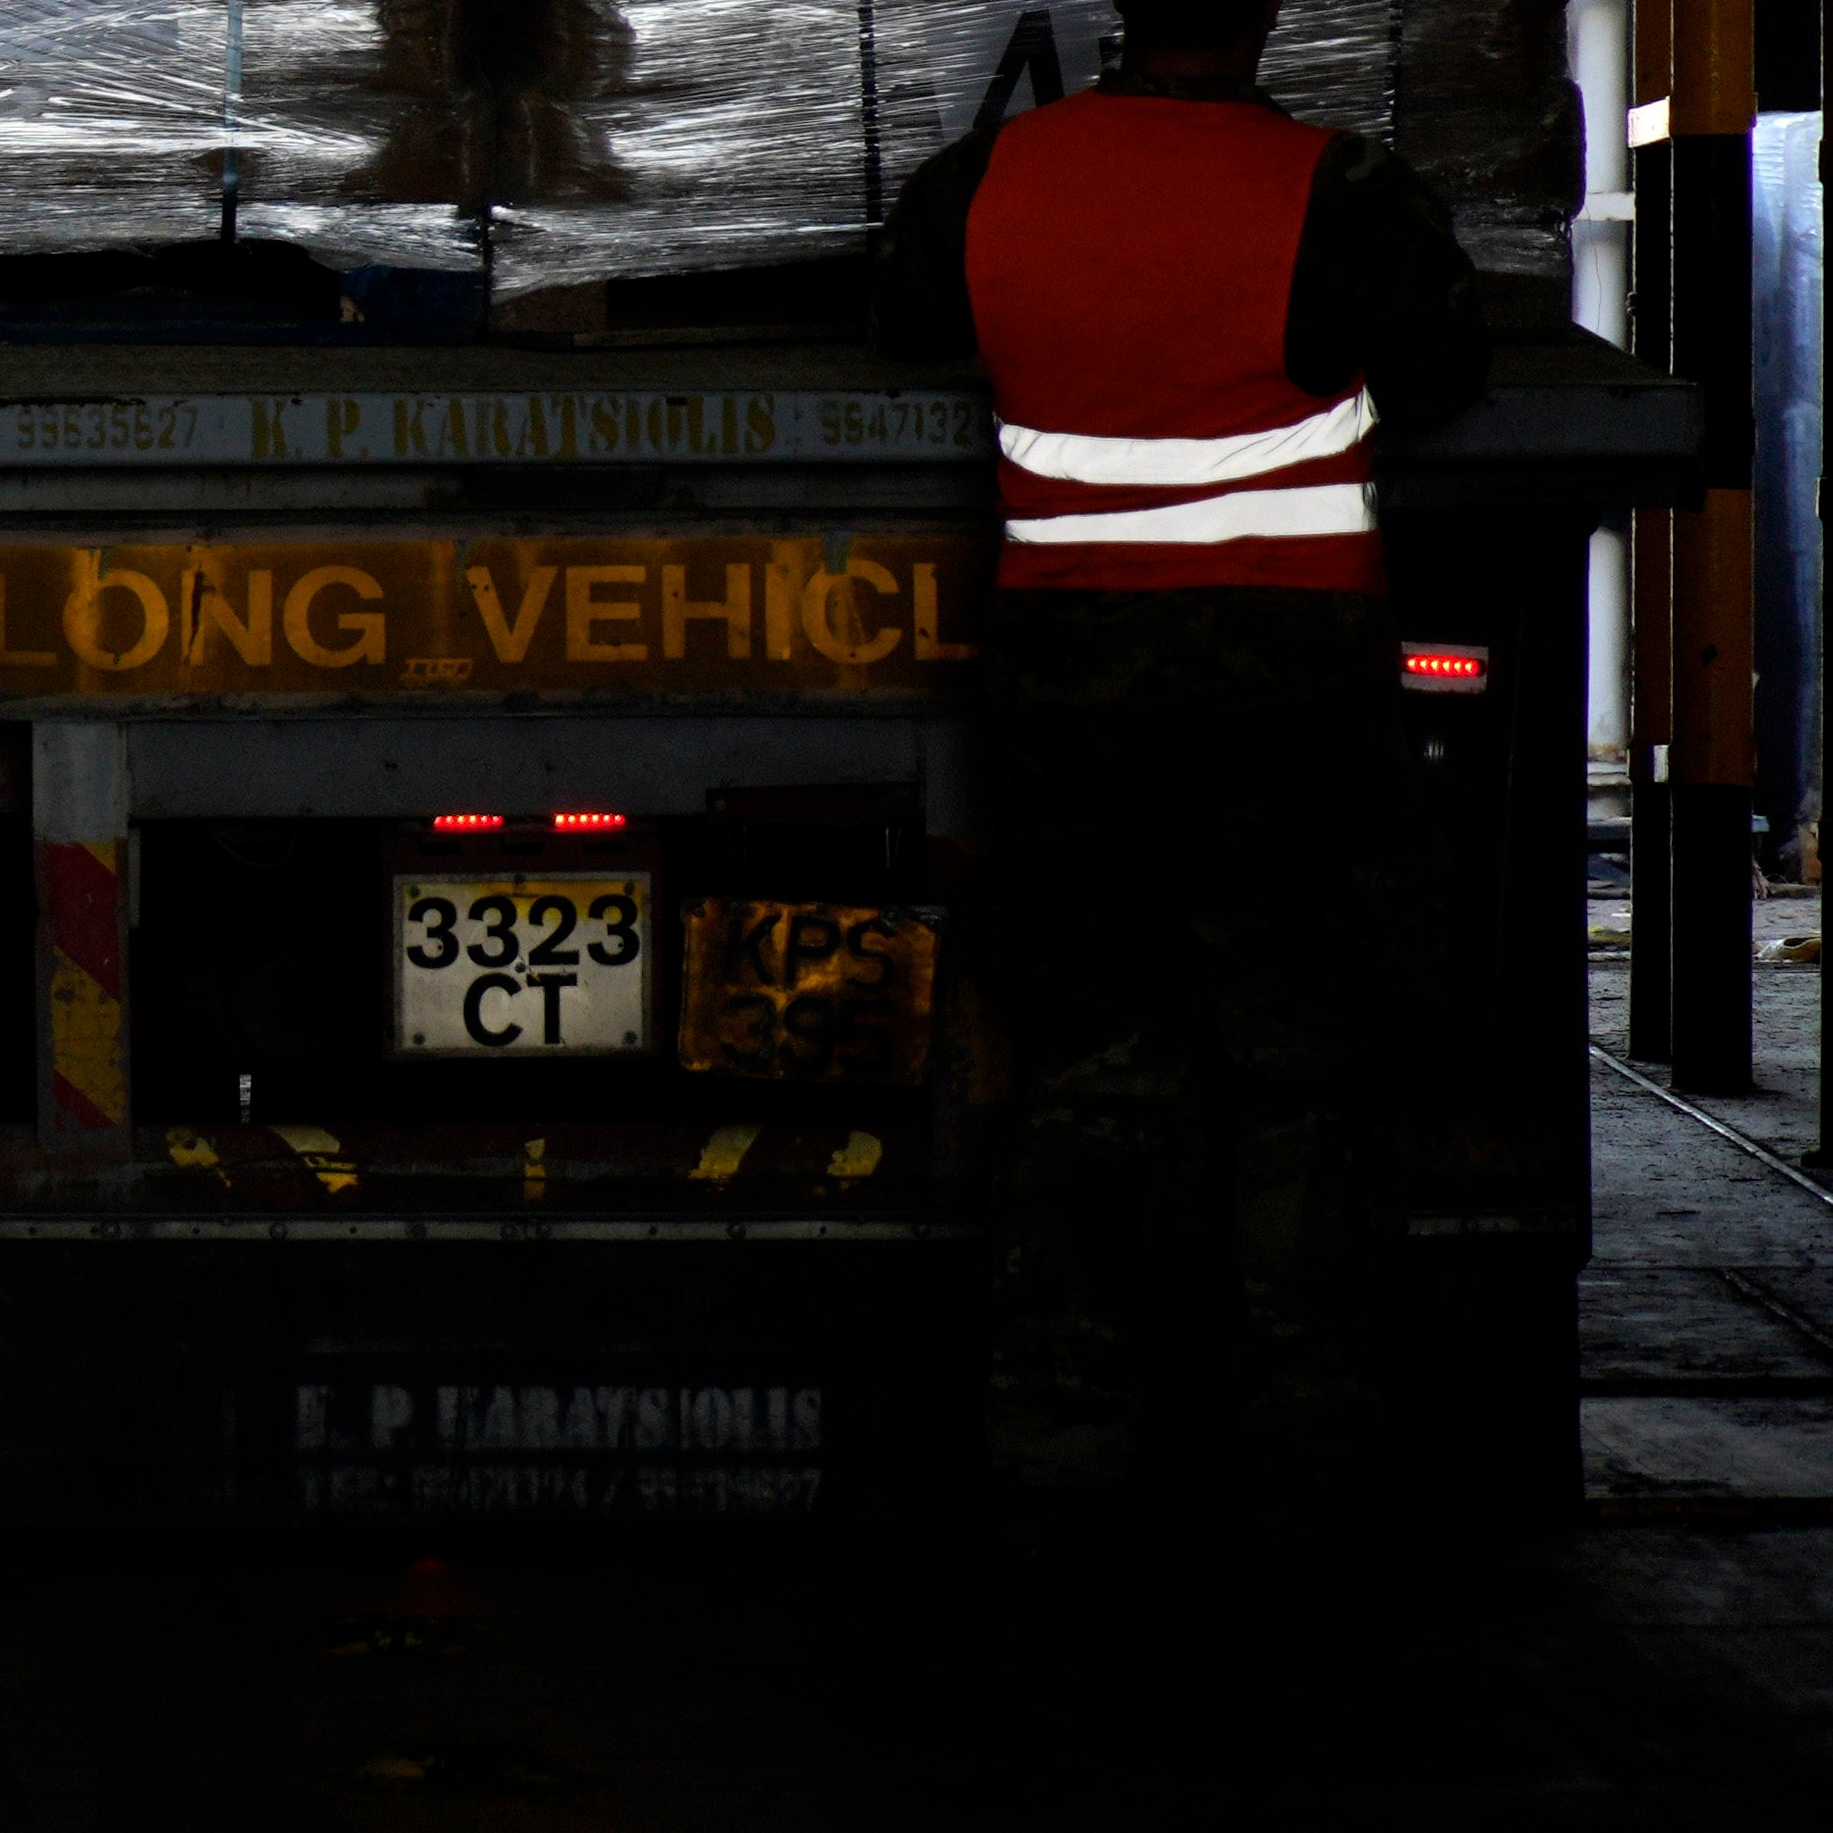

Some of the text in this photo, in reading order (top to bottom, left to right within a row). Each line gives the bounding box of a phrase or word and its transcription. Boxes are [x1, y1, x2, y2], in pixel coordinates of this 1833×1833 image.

[392, 395, 776, 461] KARATSIOLIS
[469, 561, 981, 667] VEHICL
[406, 894, 641, 969] 3323
[729, 914, 895, 993] KPS
[463, 972, 578, 1047] CT
[725, 996, 896, 1068] 395
